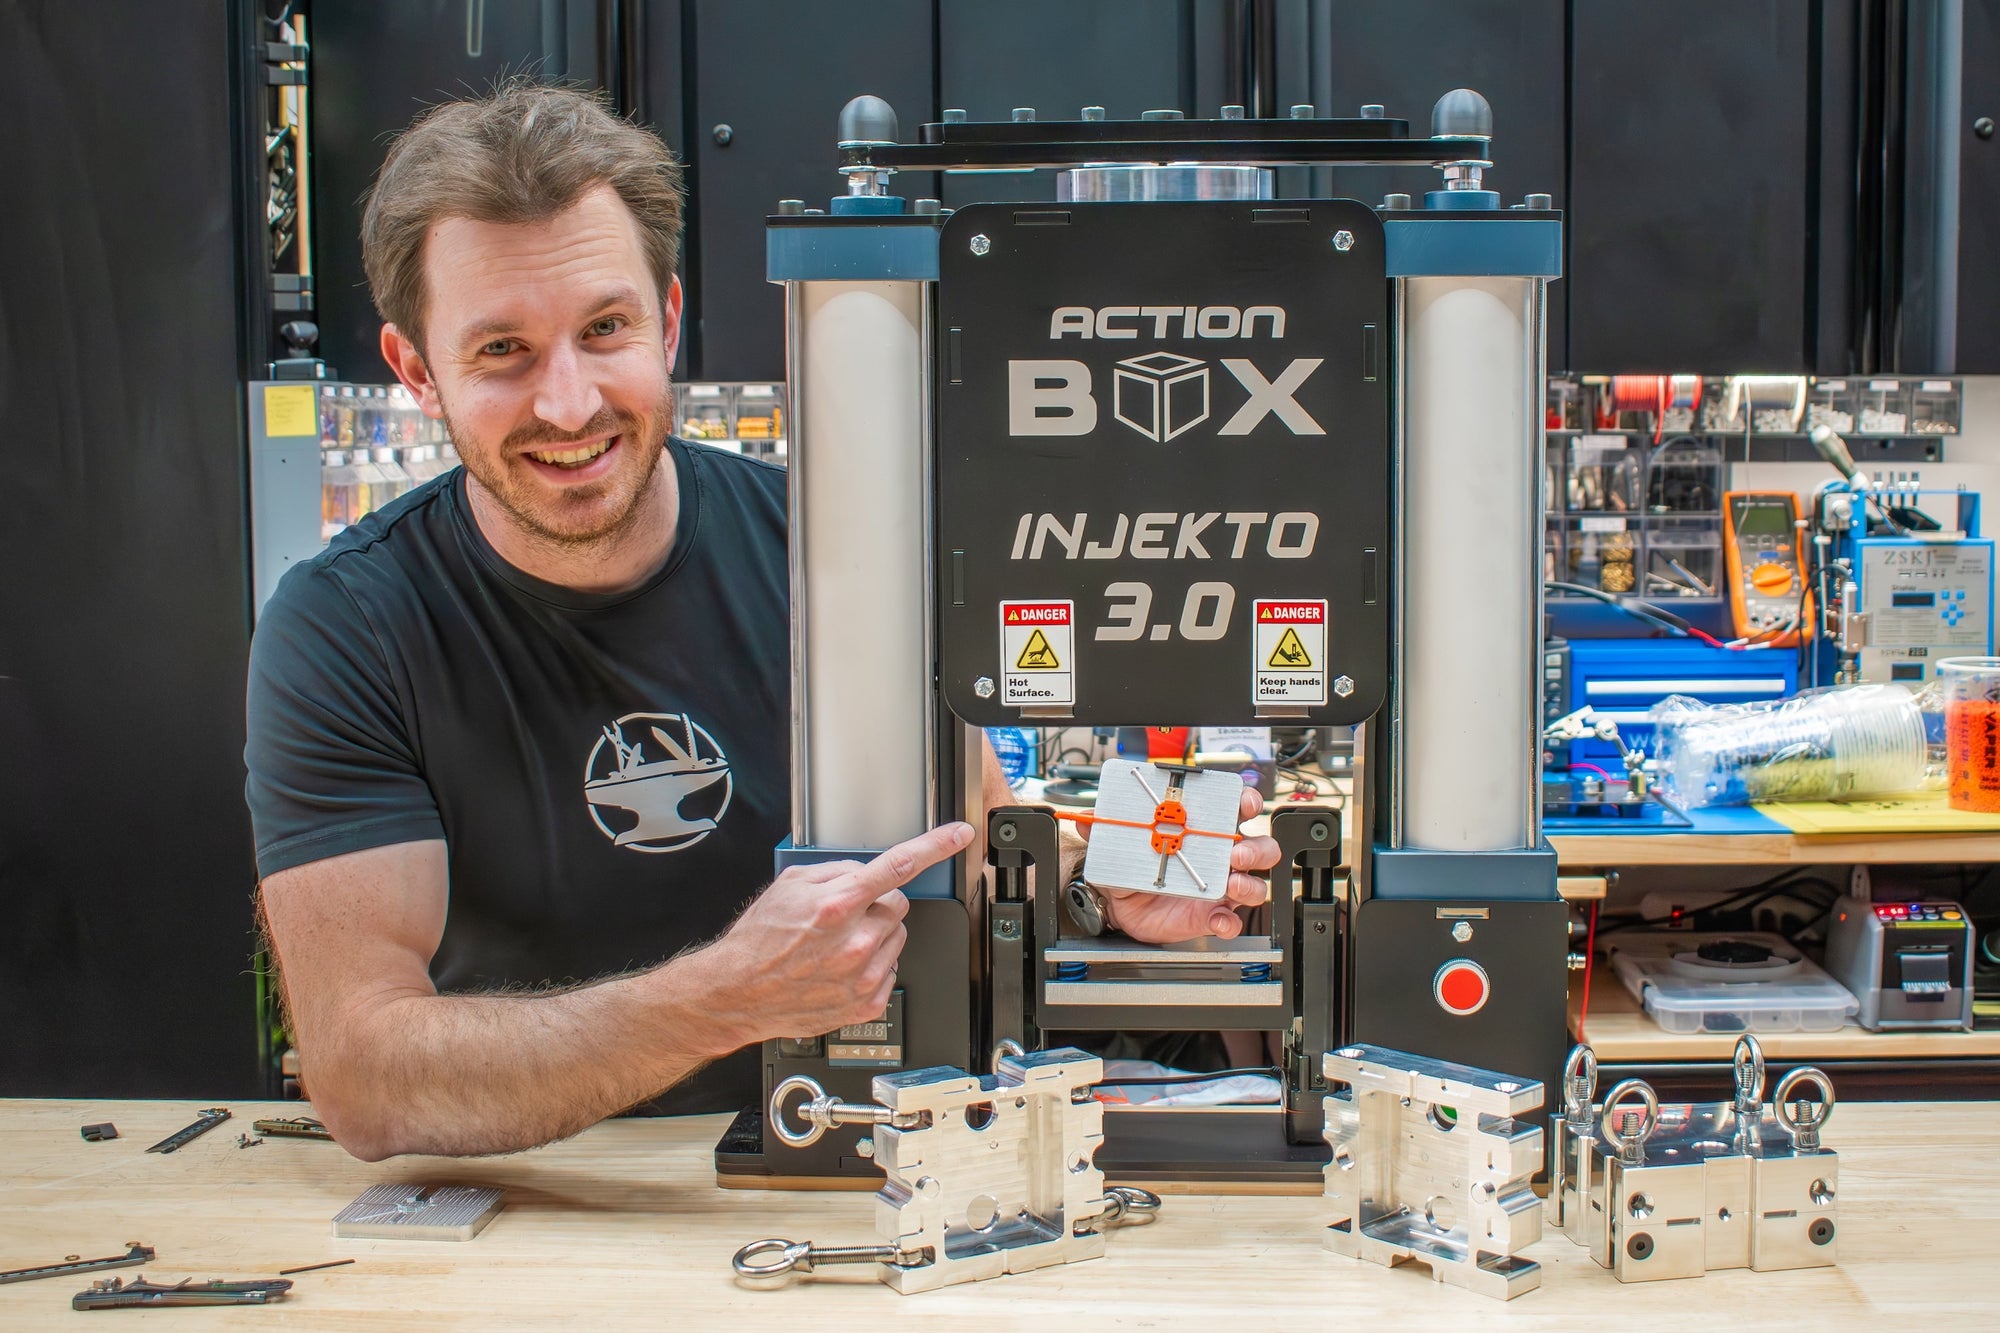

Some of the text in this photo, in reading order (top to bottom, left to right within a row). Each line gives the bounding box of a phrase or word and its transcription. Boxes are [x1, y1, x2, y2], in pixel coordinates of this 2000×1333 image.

[1049, 306, 1286, 340] ACTION
[1010, 512, 1320, 560] INJEKTO
[1021, 608, 1067, 621] DANGER
[1094, 581, 1236, 641] 3.0
[1273, 607, 1321, 619] DANGER
[1009, 678, 1028, 687] Hot
[1260, 677, 1321, 687] Keep hands
[1009, 689, 1055, 697] Surface.
[1260, 687, 1289, 695] clear.
